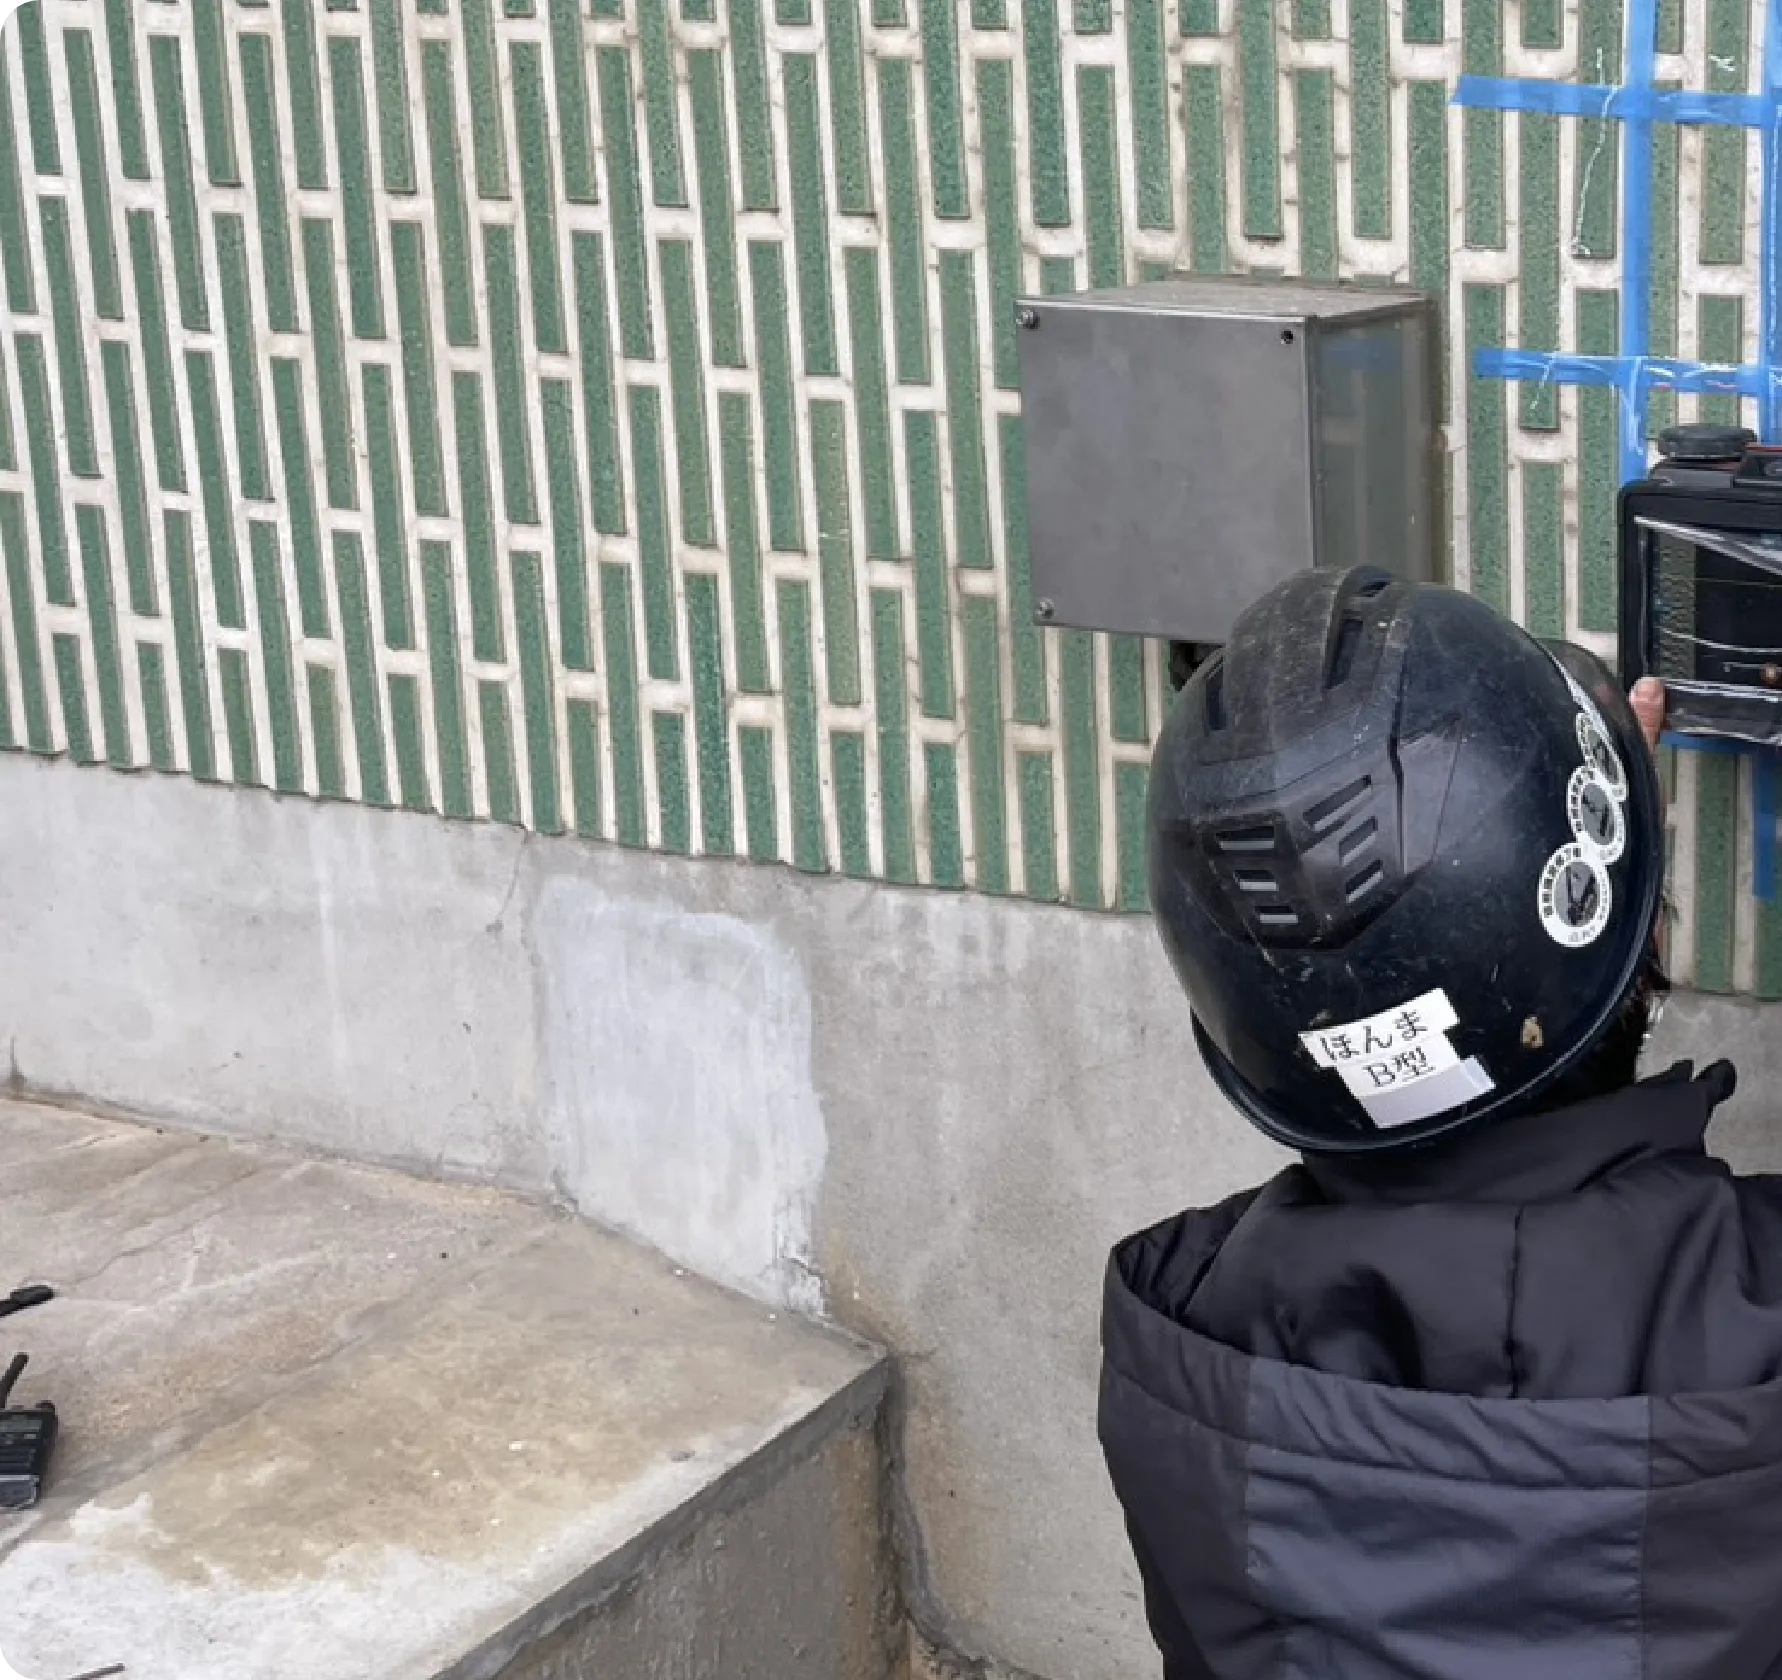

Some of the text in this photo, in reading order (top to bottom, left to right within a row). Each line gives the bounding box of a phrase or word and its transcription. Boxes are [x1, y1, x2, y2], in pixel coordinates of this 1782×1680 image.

[1320, 1011, 1428, 1061] ほんま
[1363, 1046, 1437, 1088] B型
